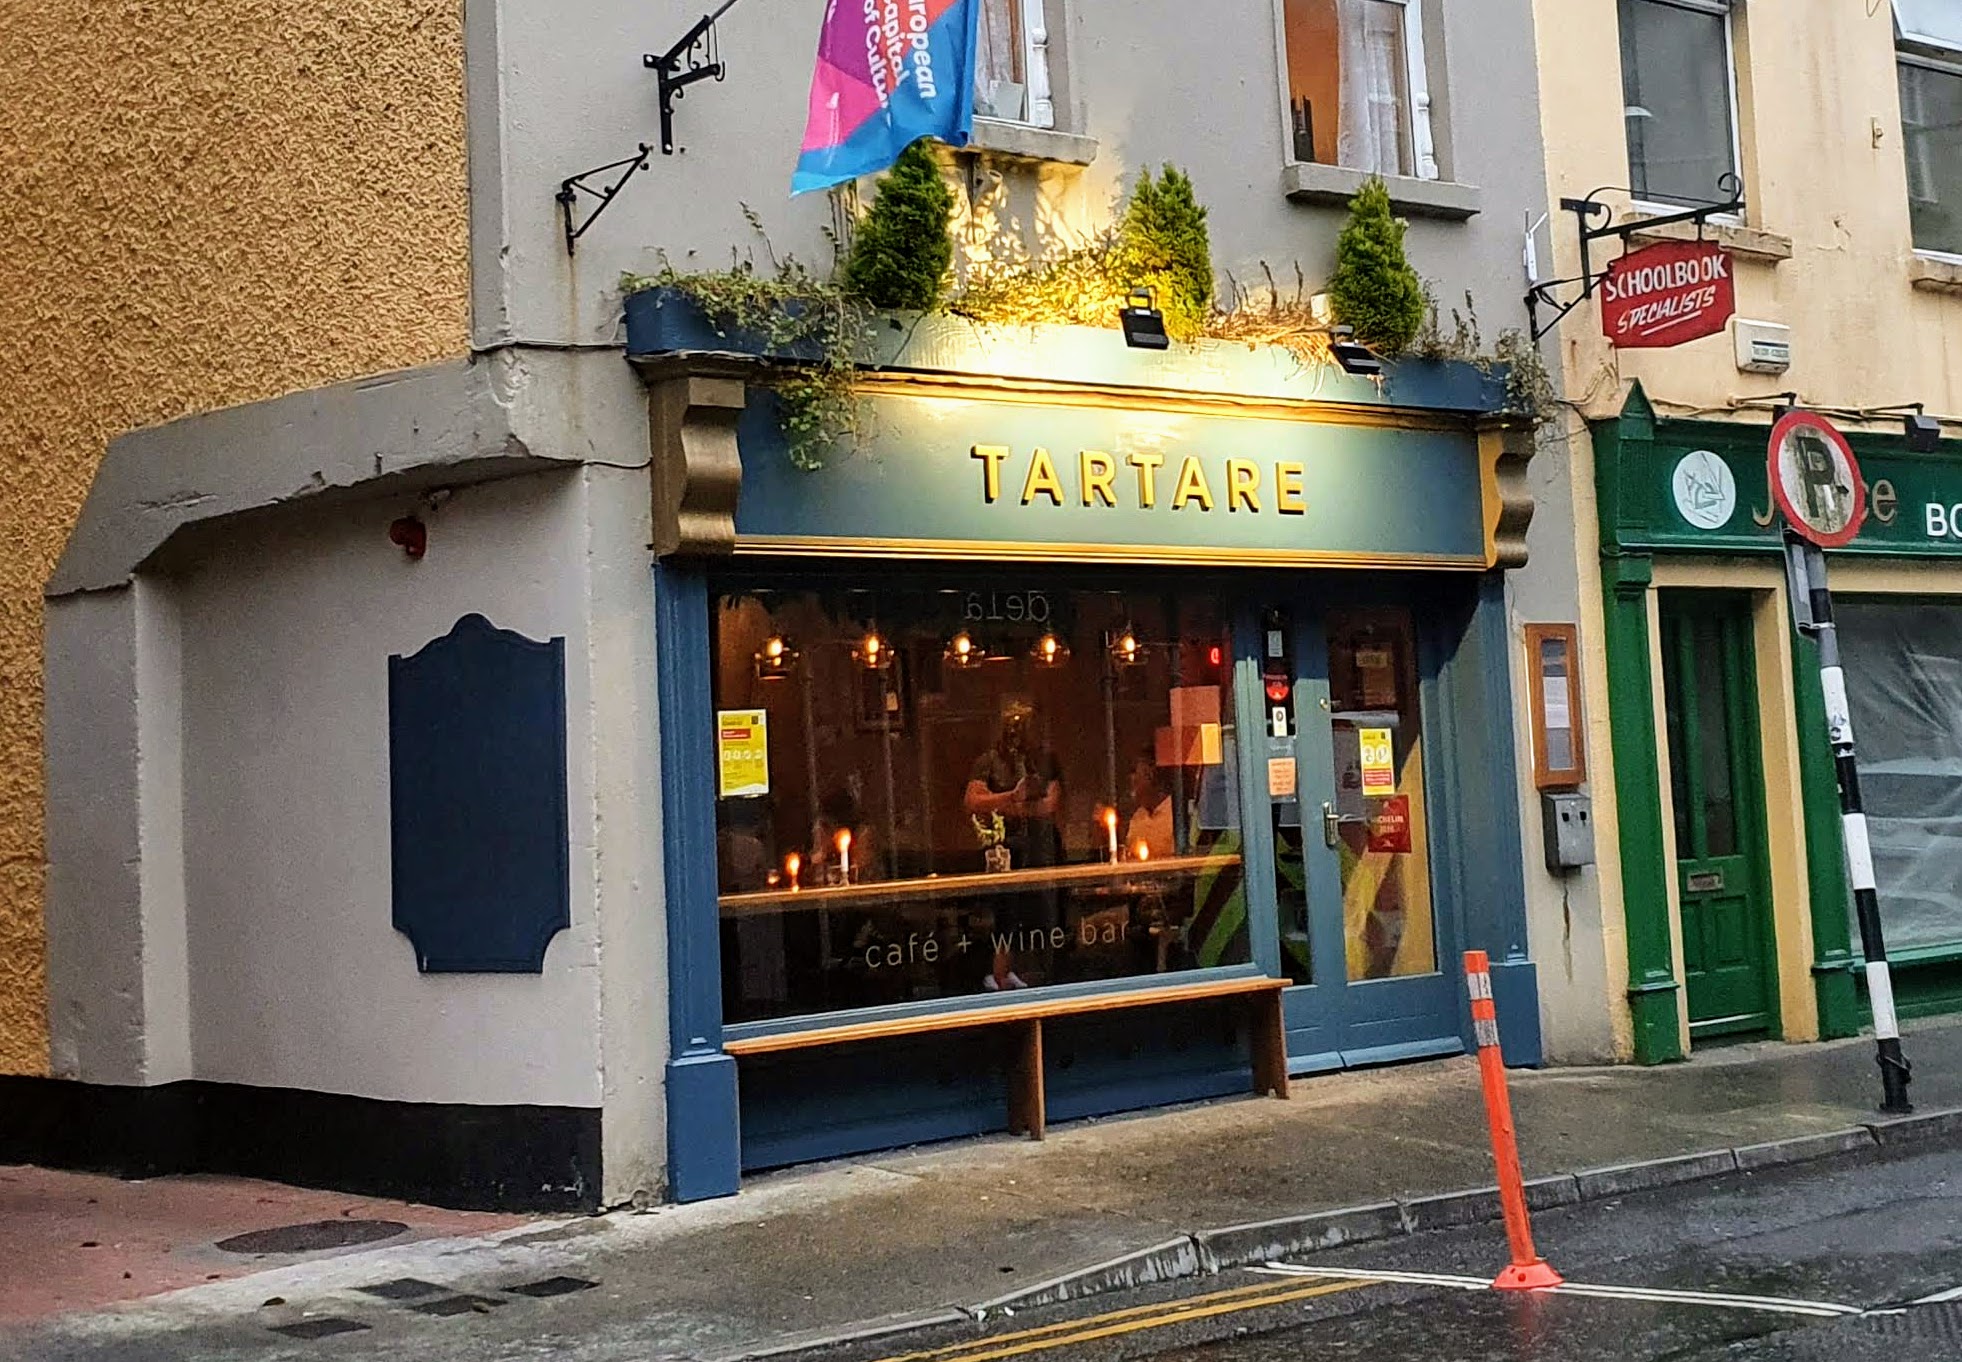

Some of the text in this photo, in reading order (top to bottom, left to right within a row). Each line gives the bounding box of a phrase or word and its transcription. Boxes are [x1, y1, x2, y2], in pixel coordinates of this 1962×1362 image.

[882, 0, 911, 86] apital
[1605, 253, 1729, 302] SCHOOLBOOK
[1617, 284, 1717, 334] SPECIALISTS
[970, 443, 1309, 516] TARTARE
[864, 916, 1130, 969] café + wine bar
